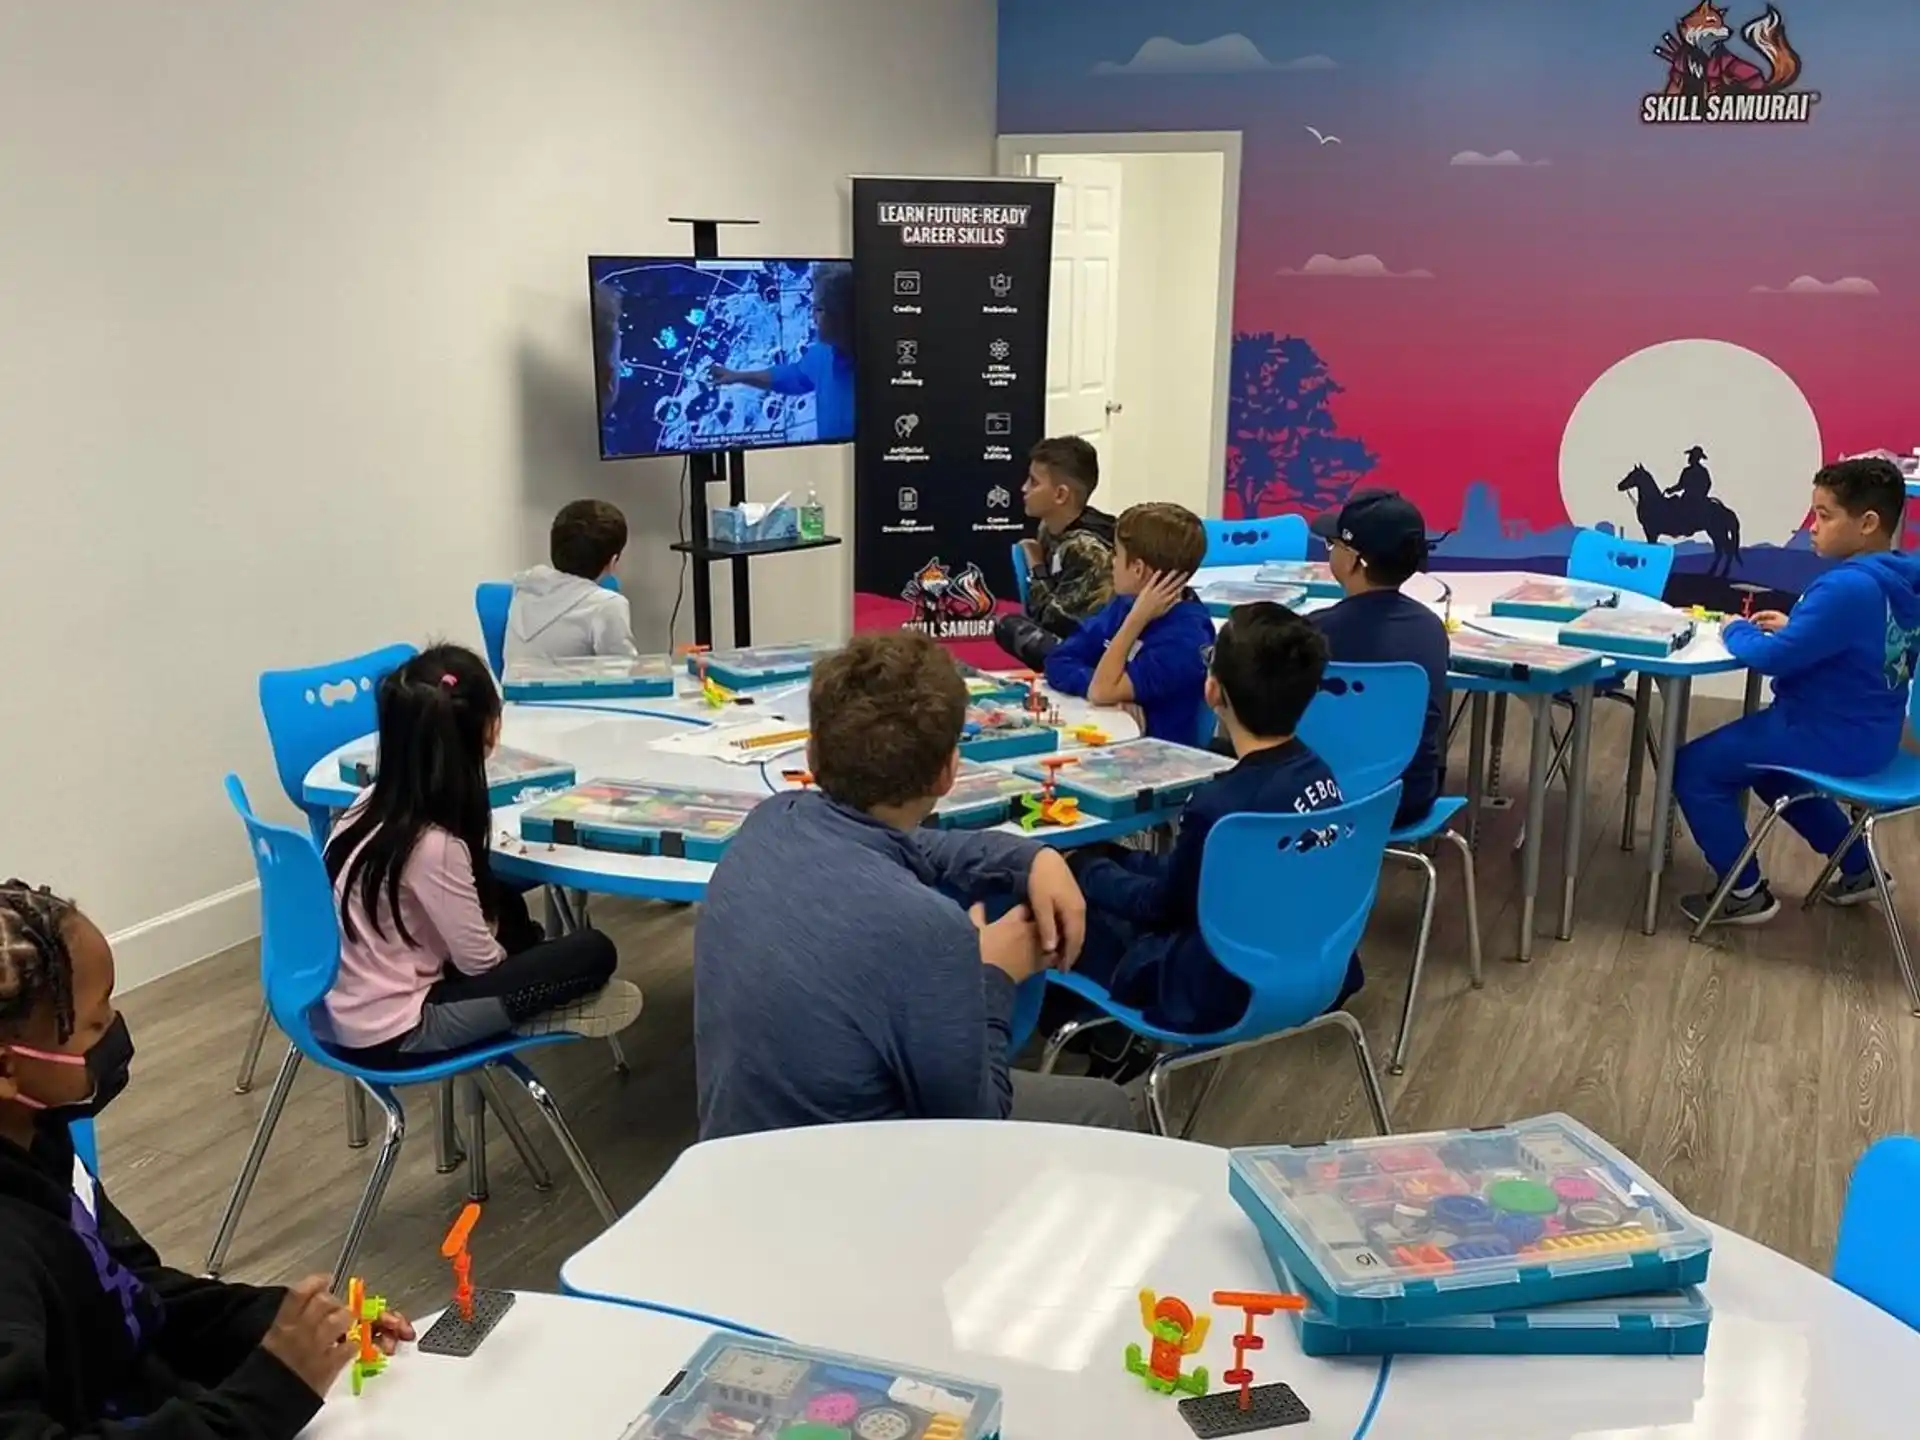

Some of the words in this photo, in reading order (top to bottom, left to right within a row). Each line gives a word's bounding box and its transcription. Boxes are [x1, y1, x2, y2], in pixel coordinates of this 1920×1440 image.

[1643, 96, 1702, 122] SKILL
[1706, 94, 1810, 121] SAMURAI
[880, 205, 926, 223] LEARN
[926, 206, 1029, 225] FUTURE-READY
[903, 226, 956, 244] CAREER
[957, 228, 1006, 245] SKILLS
[893, 305, 922, 314] Coding
[983, 305, 1018, 314] Robotics
[981, 372, 1017, 380] Learning
[891, 378, 923, 387] Printing
[889, 446, 924, 454] Artificial
[883, 454, 930, 463] Intelligence
[984, 453, 1012, 461] Editing
[900, 518, 917, 526] App
[882, 525, 934, 533] Development
[972, 523, 1024, 531] Development
[940, 619, 996, 638] SAMURA
[1293, 778, 1344, 816] EEBO
